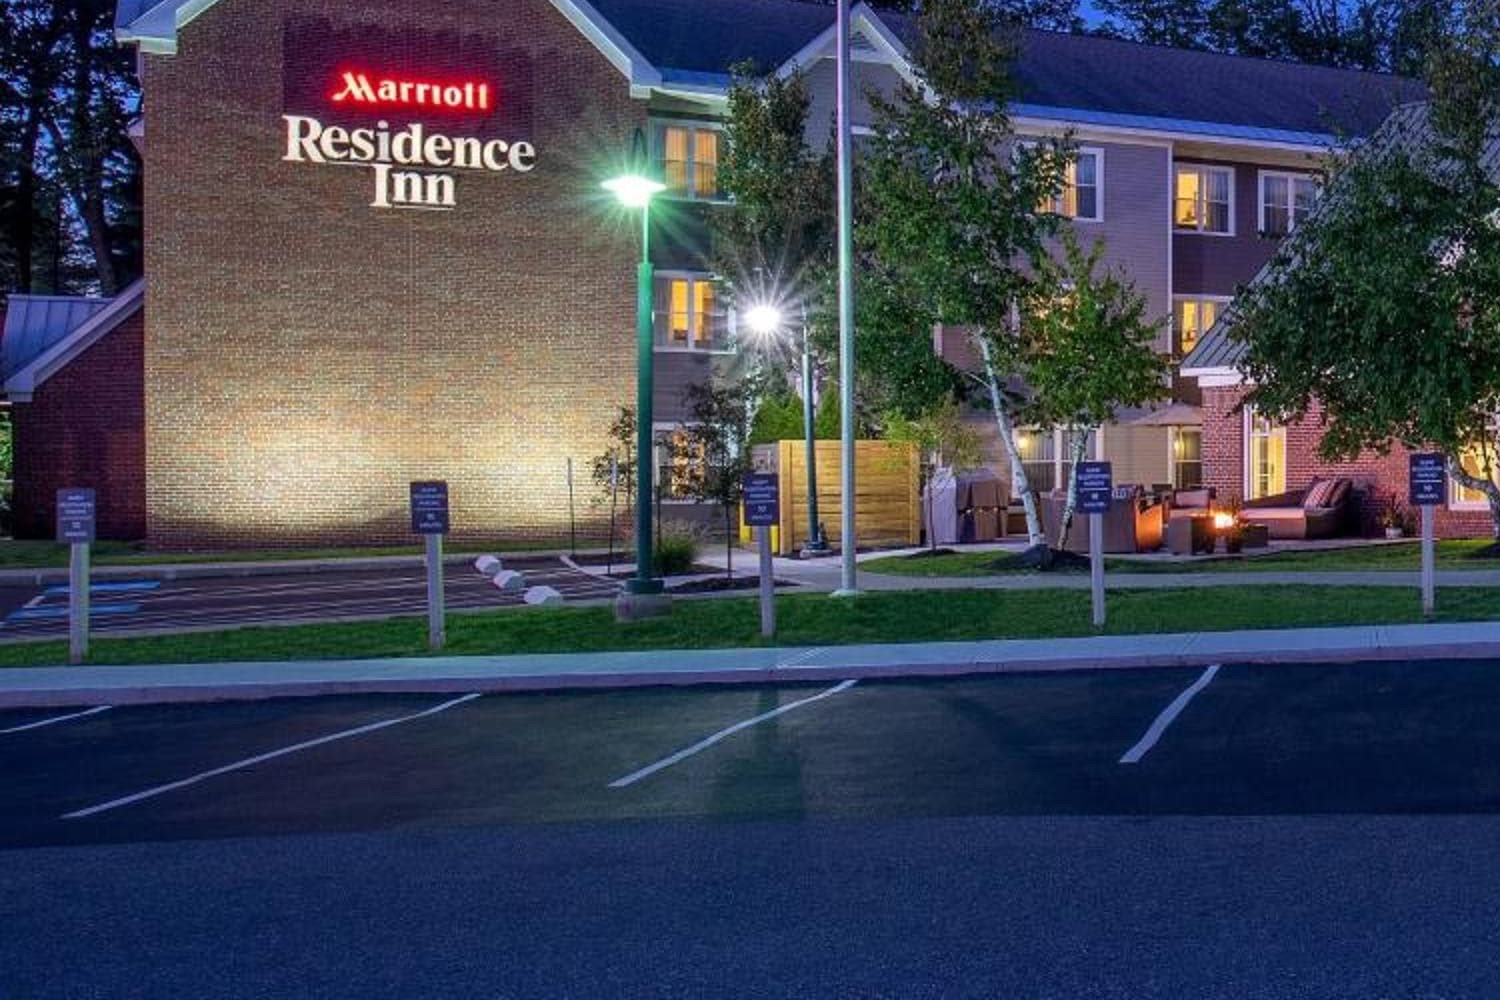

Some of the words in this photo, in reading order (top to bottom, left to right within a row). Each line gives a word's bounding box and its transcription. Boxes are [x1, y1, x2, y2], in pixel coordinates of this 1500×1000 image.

[332, 71, 488, 109] Marriott
[281, 114, 536, 172] Residence
[369, 163, 456, 208] Inn
